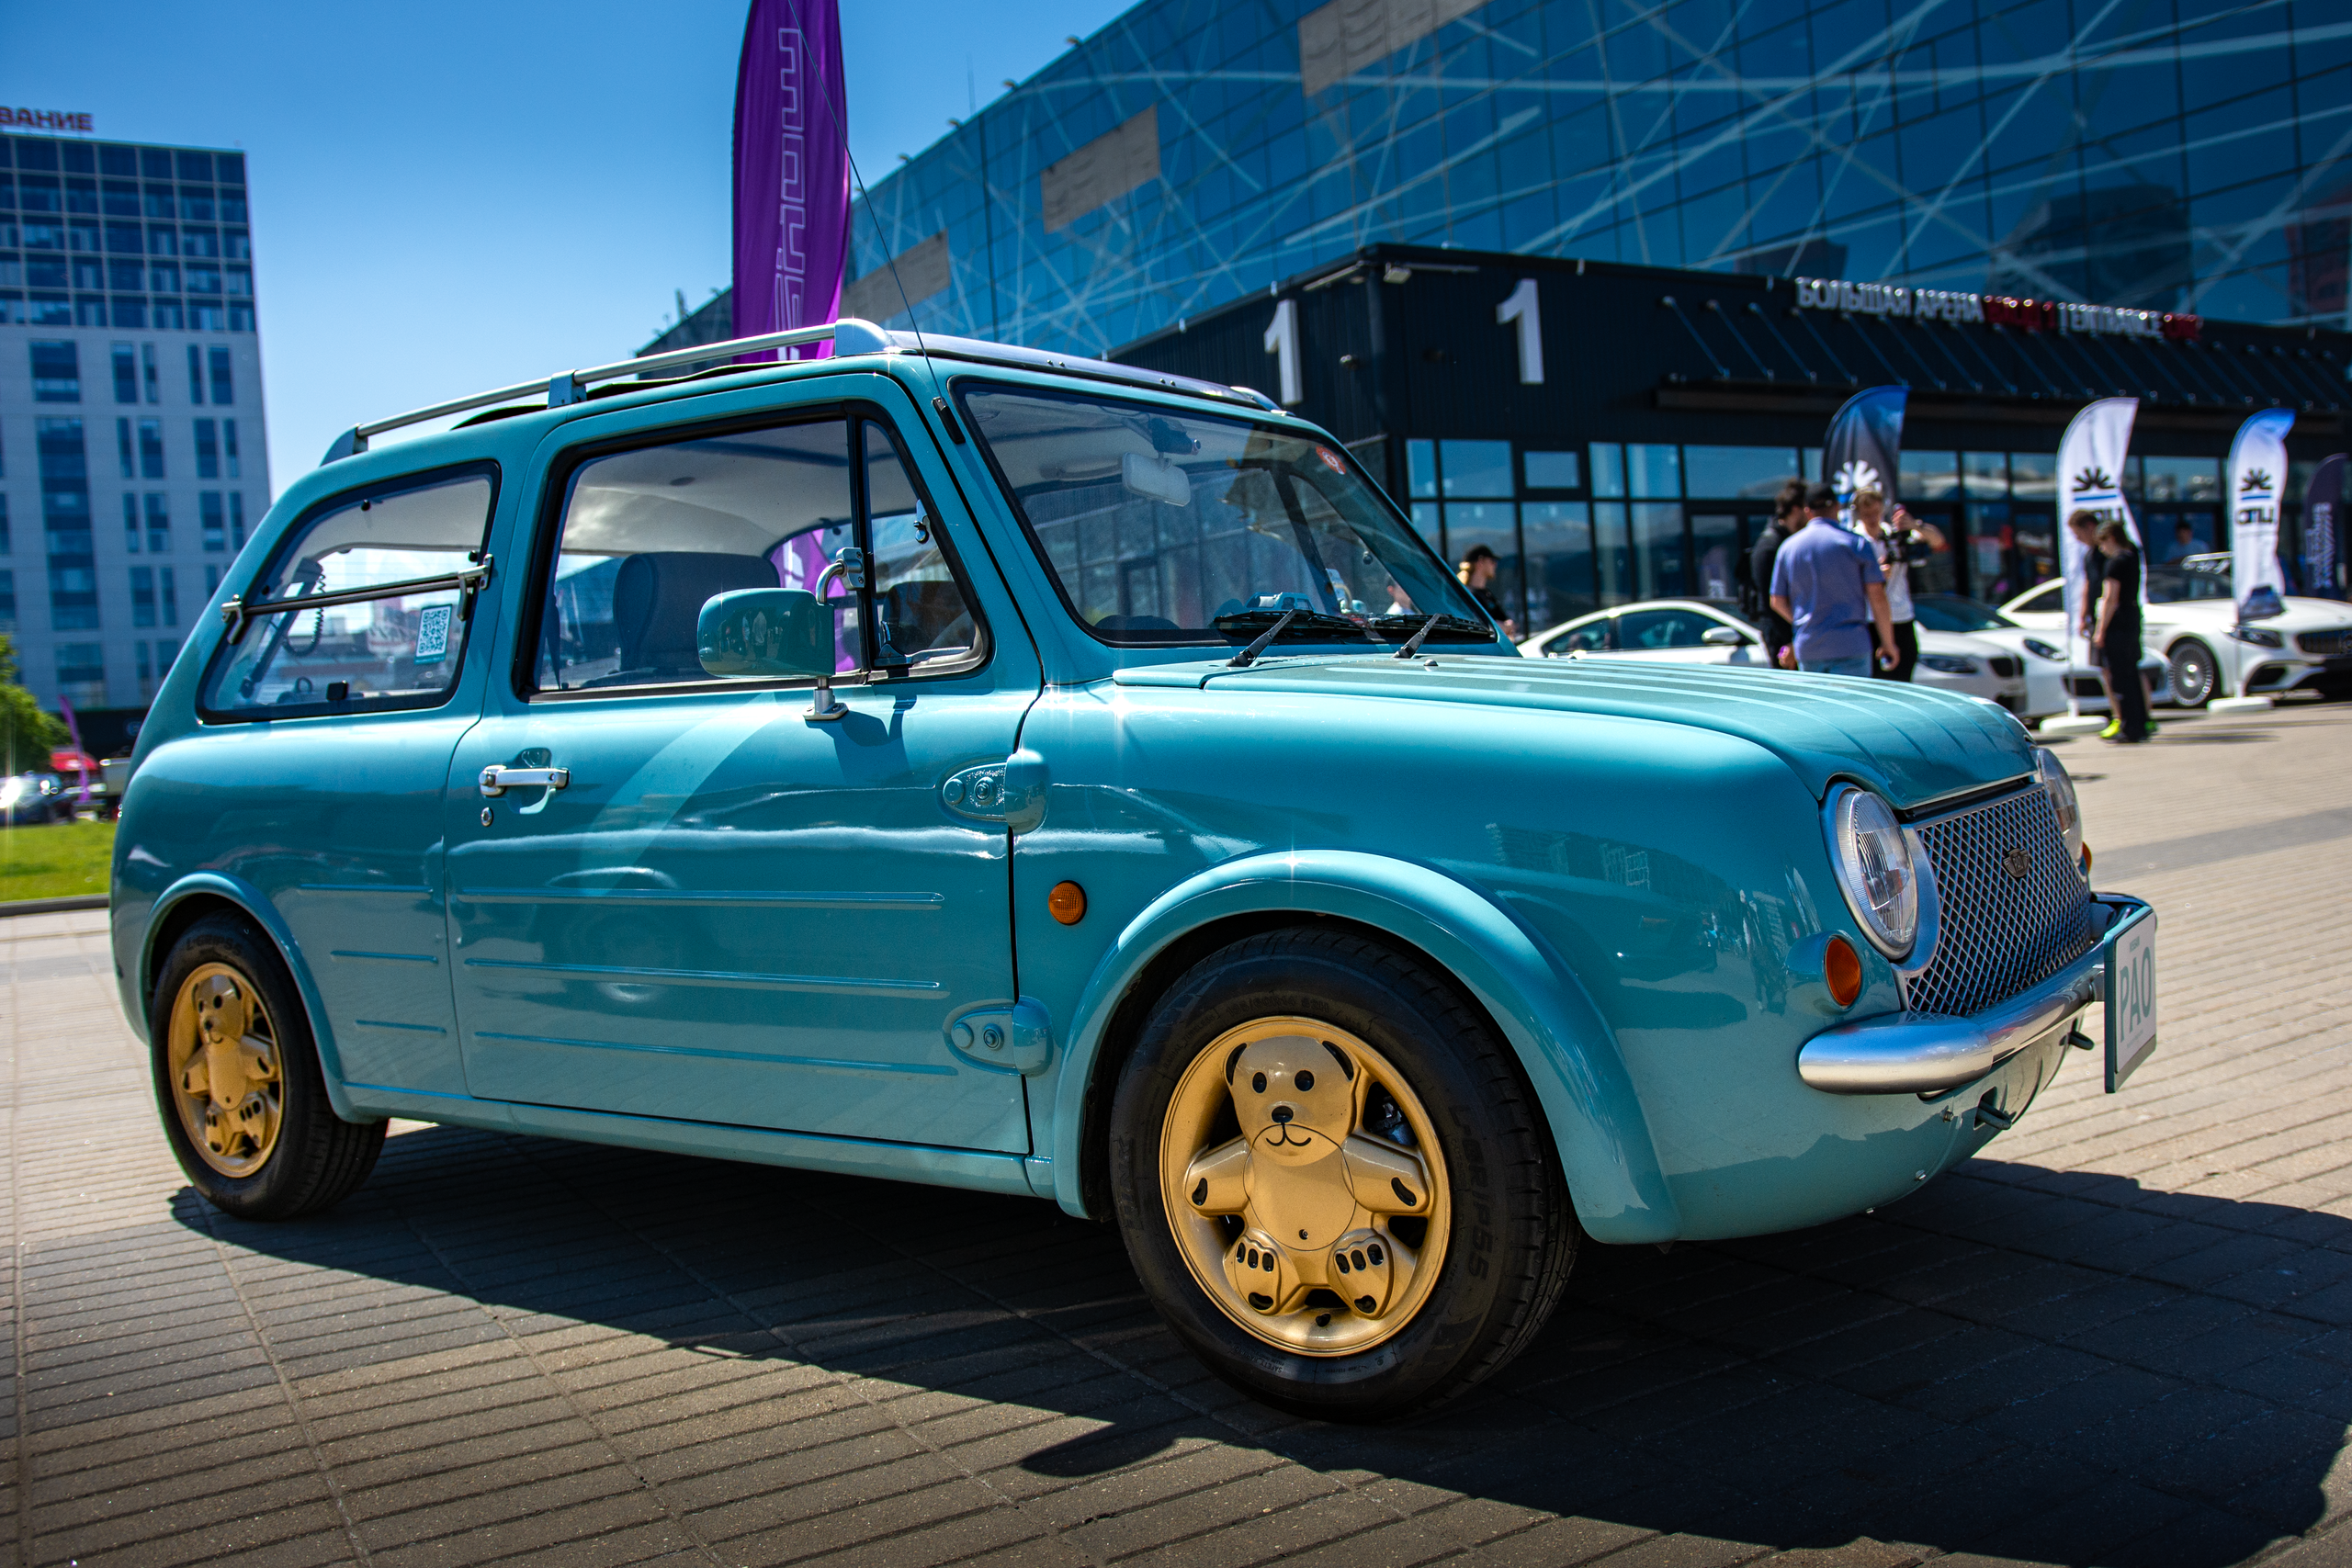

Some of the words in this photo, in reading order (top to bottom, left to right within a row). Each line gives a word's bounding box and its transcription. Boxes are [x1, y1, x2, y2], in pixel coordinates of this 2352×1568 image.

[0, 106, 94, 131] ВАНИЕ
[1496, 277, 1544, 385] 1
[1795, 276, 1911, 317] БОЛЬШАЯ
[1915, 288, 1985, 323] АРЕНА
[1263, 298, 1303, 406] 1
[2120, 946, 2152, 1043] PAO
